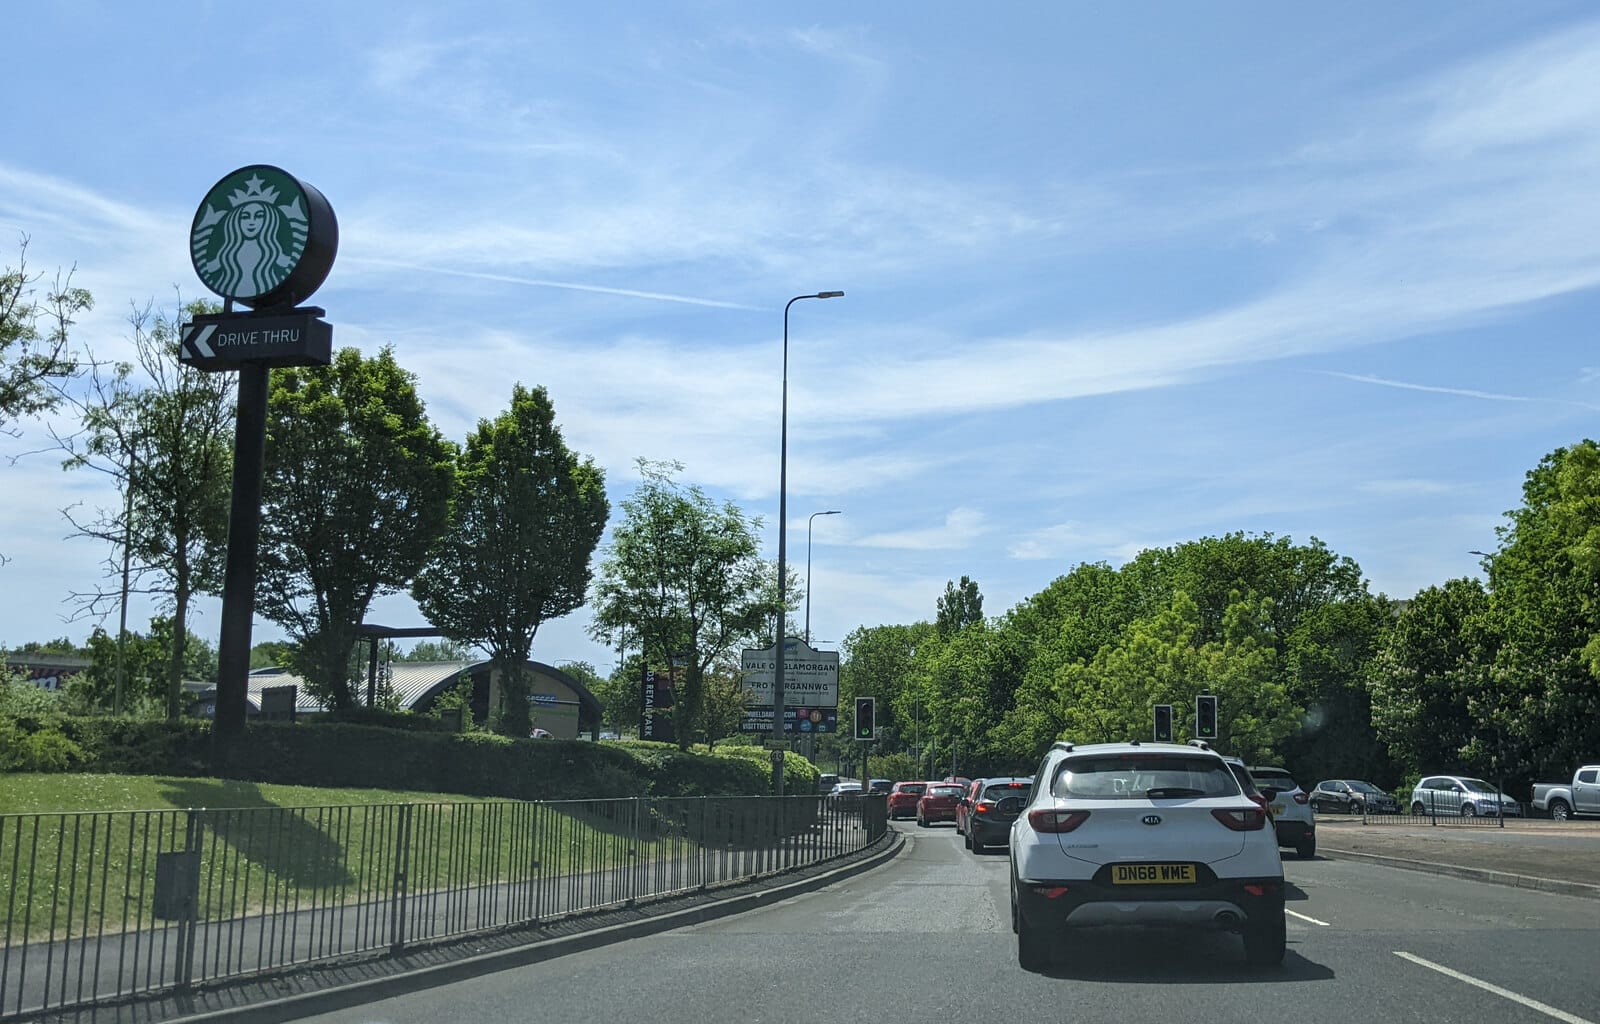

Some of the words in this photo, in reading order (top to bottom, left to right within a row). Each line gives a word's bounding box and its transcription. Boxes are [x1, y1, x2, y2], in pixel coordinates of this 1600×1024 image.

[217, 331, 259, 347] DRIVE
[262, 329, 300, 344] THRU
[784, 663, 836, 671] GLAMORGAN
[751, 681, 769, 689] FRO
[645, 684, 654, 713] RETAIL
[644, 714, 653, 737] PARK
[1144, 816, 1159, 824] KIA
[1117, 866, 1157, 881] DN68
[1160, 865, 1190, 880] WME
